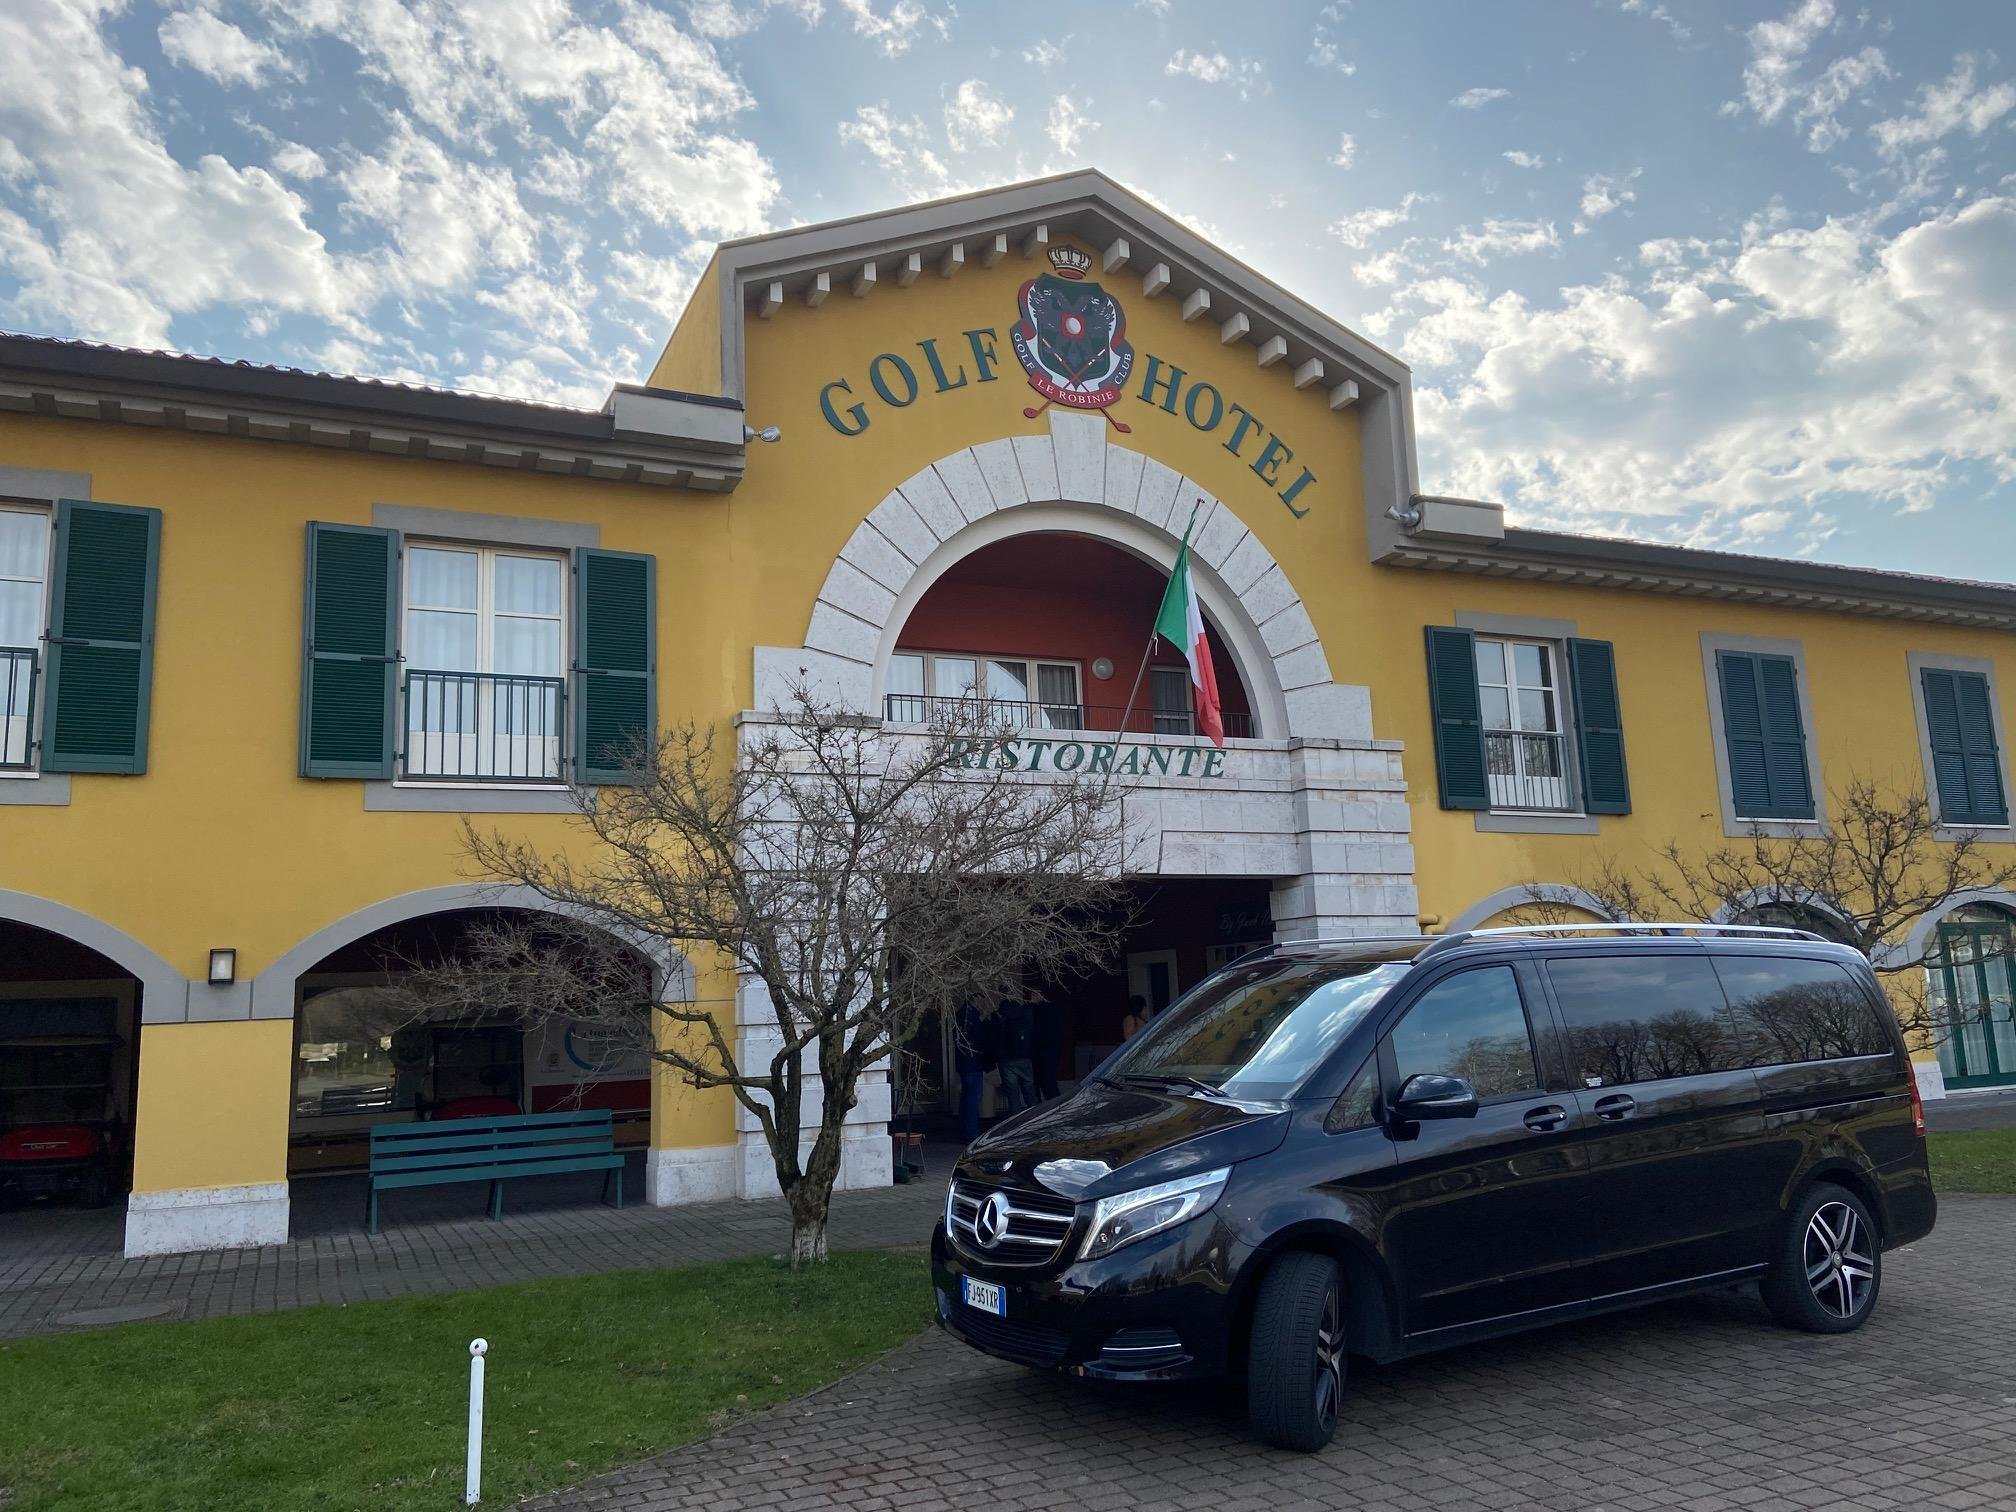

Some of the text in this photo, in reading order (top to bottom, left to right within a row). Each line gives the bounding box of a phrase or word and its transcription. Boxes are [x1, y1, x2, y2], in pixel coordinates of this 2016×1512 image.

[1014, 333, 1131, 385] GOLF CLUB
[1037, 378, 1114, 404] LE ROBINIE
[820, 327, 1317, 520] GOLF HOTEL
[945, 739, 1227, 778] RISTORANTE
